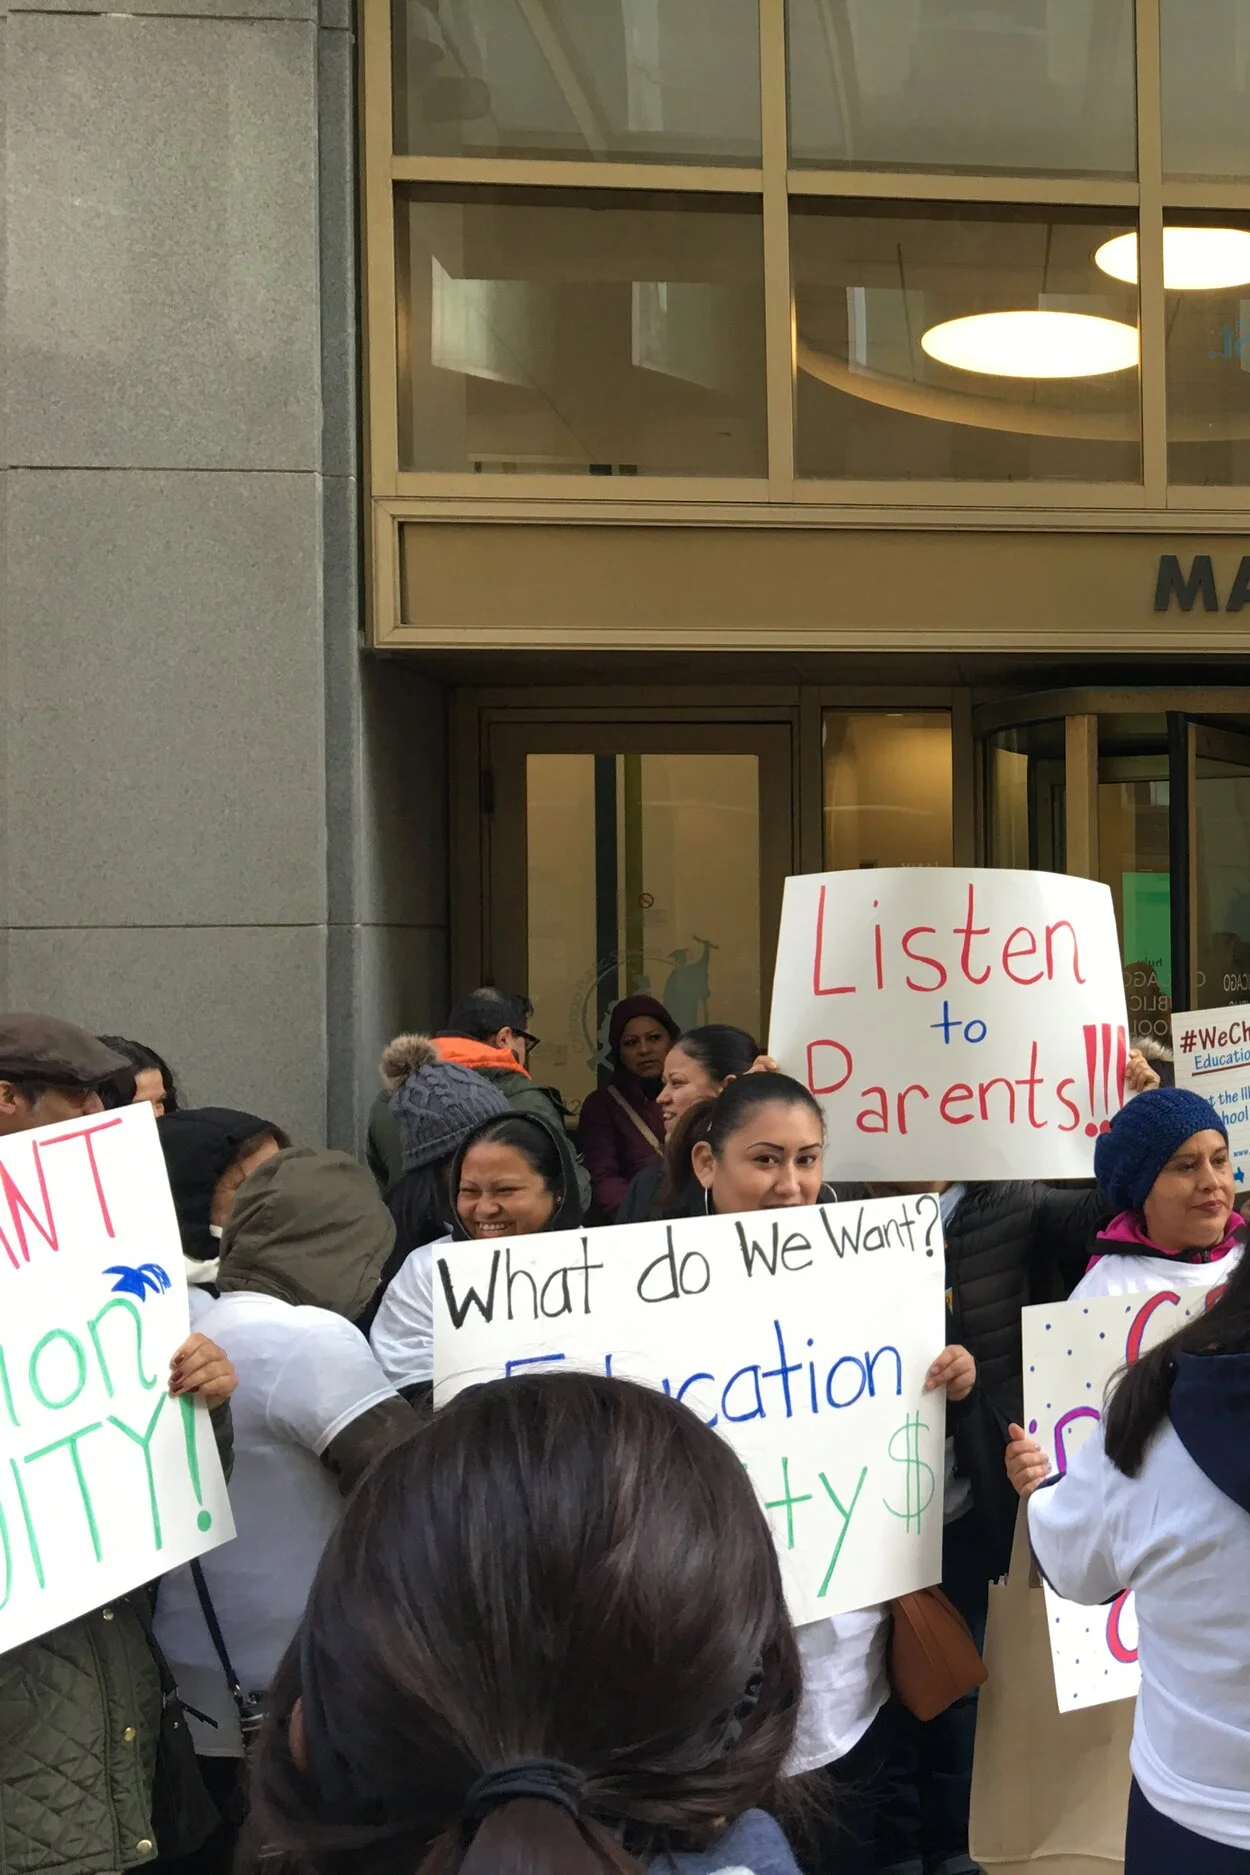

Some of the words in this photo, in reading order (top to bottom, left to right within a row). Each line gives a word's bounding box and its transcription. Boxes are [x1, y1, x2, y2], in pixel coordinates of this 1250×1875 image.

[813, 883, 1087, 995] Listen
[930, 1000, 987, 1045] to
[806, 1023, 1126, 1138] Parents!!!
[1219, 1091, 1239, 1106] the
[1221, 1110, 1249, 1127] hool
[0, 1117, 122, 1269] NT
[437, 1237, 603, 1329] What
[637, 1225, 711, 1303] do
[735, 1221, 813, 1278] We
[820, 1195, 940, 1259] Want?
